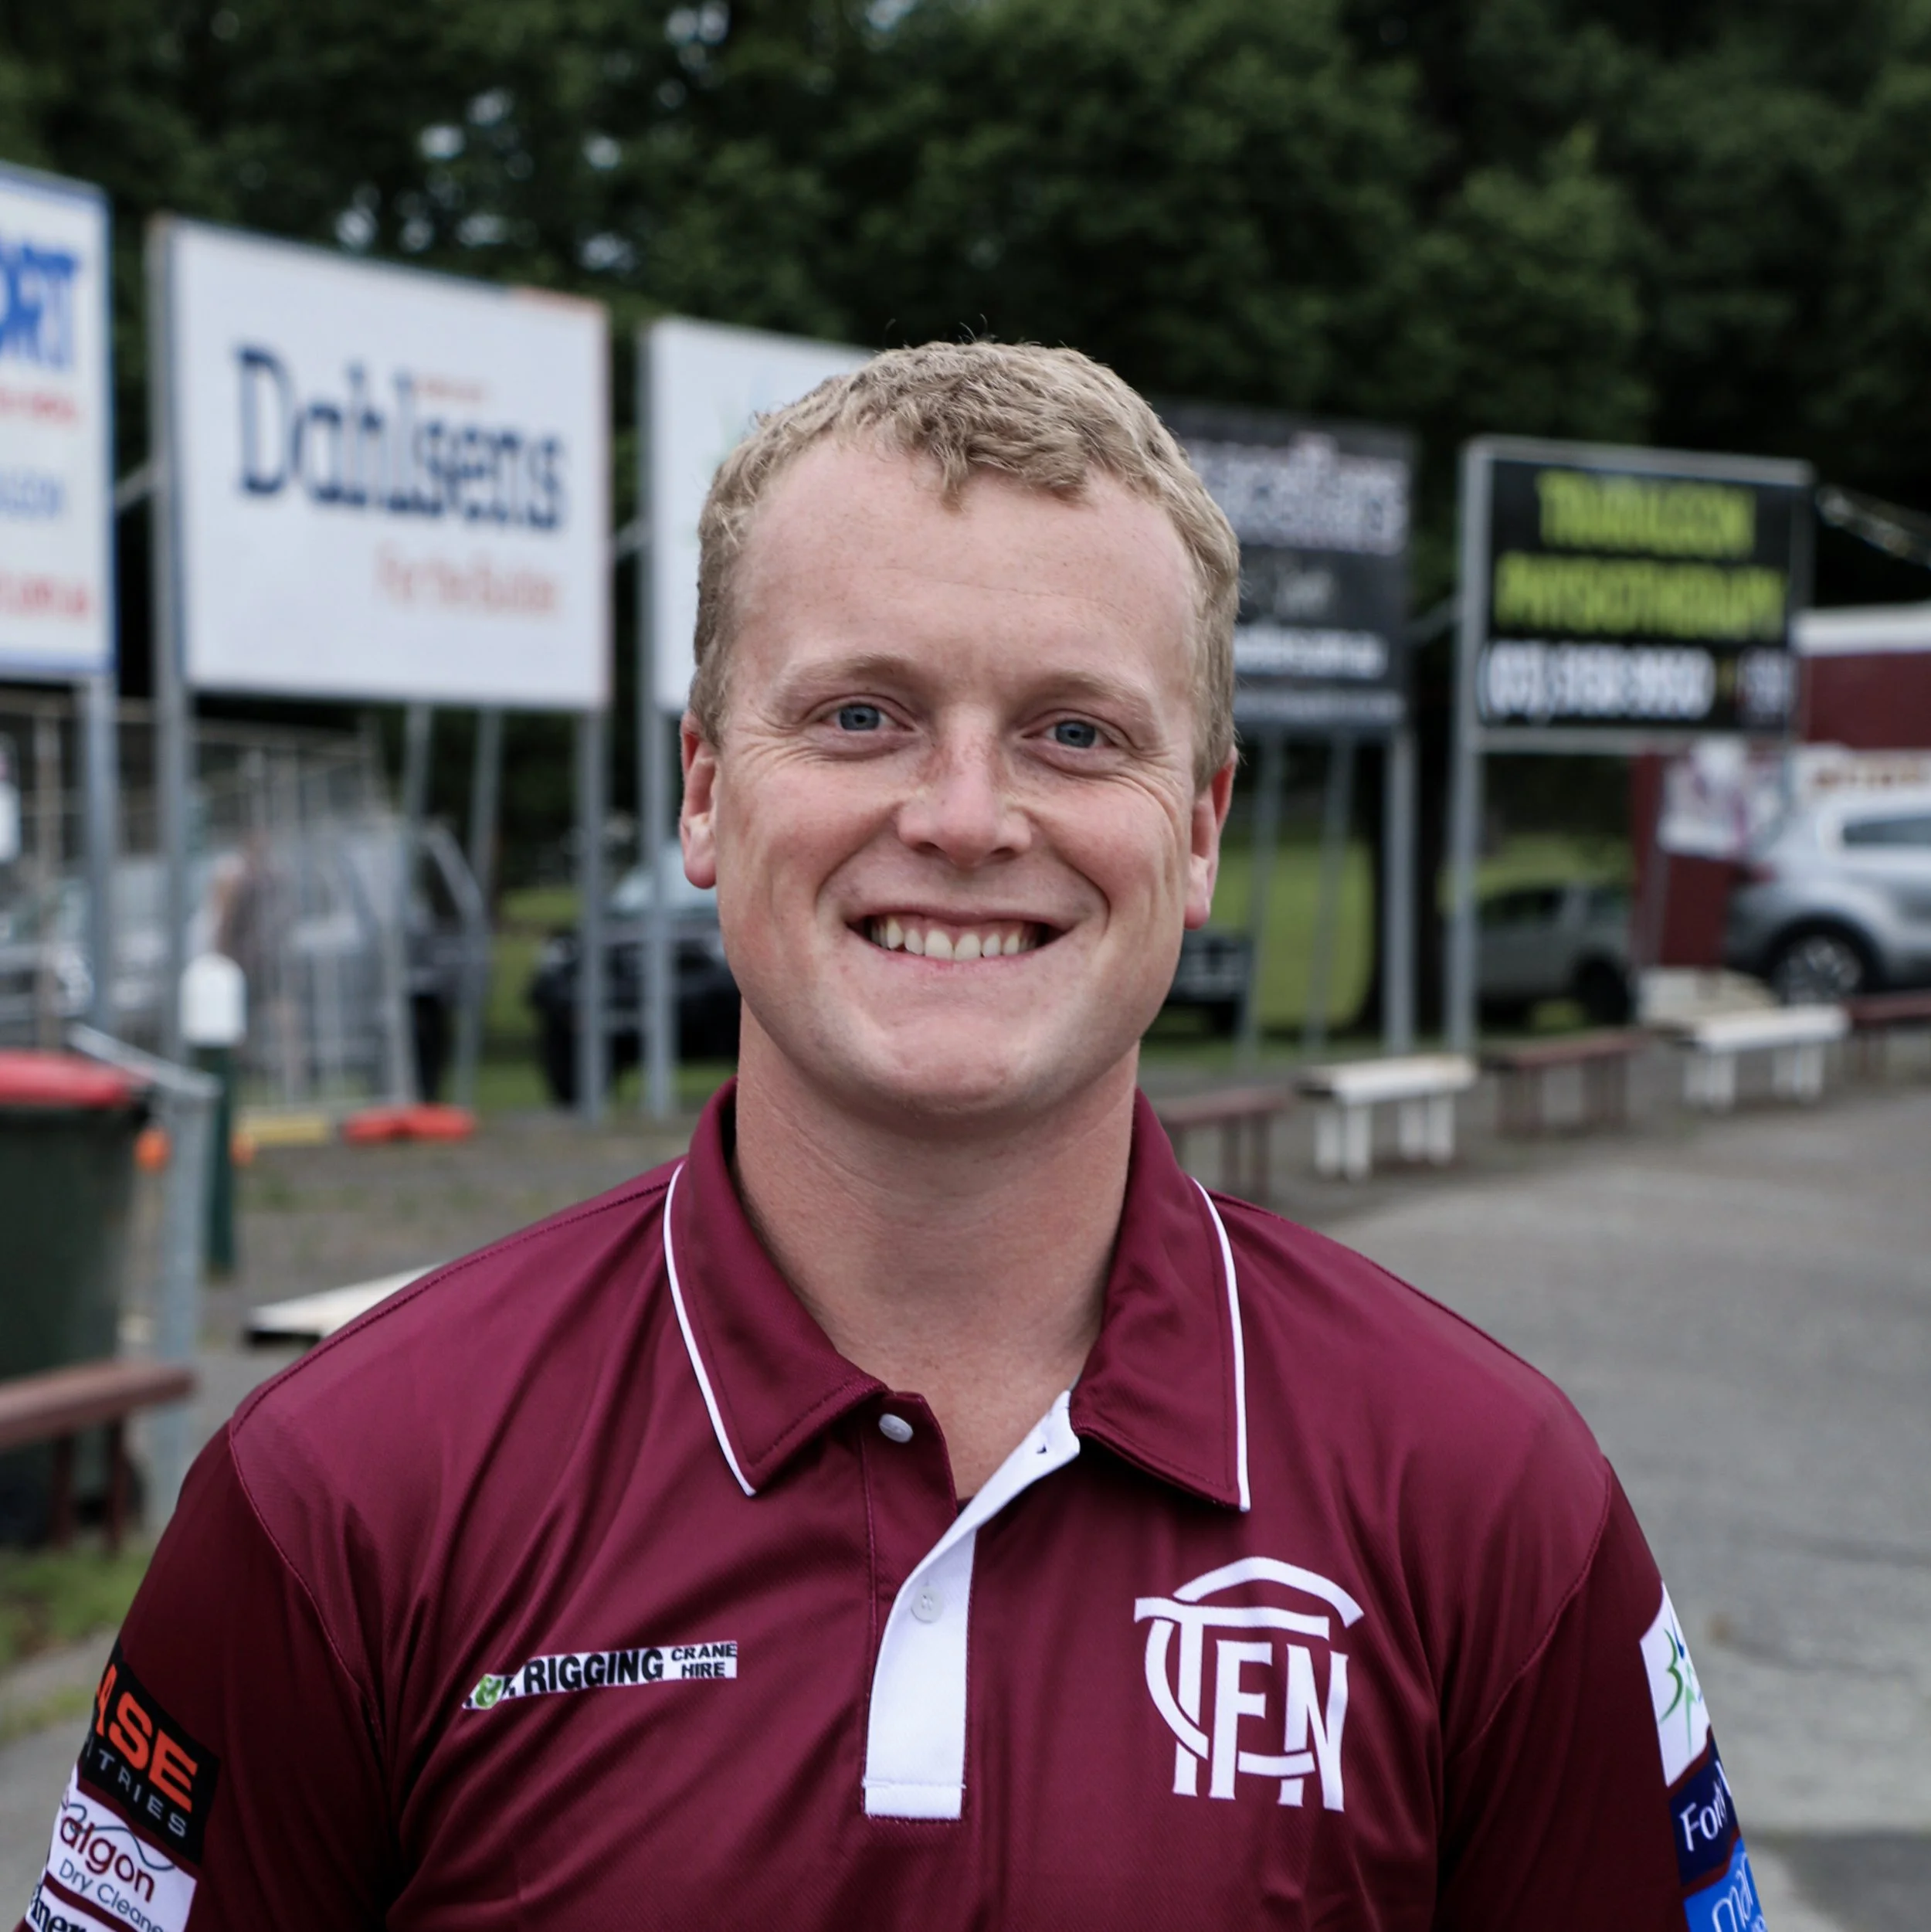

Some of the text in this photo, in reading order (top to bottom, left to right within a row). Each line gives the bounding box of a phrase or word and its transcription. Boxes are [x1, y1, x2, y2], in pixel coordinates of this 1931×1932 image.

[235, 342, 565, 531] Dahlsens
[671, 1644, 737, 1662] CRANE
[681, 1662, 725, 1678] HIRE
[524, 1649, 663, 1694] RIGGING
[59, 1858, 93, 1893] Dry
